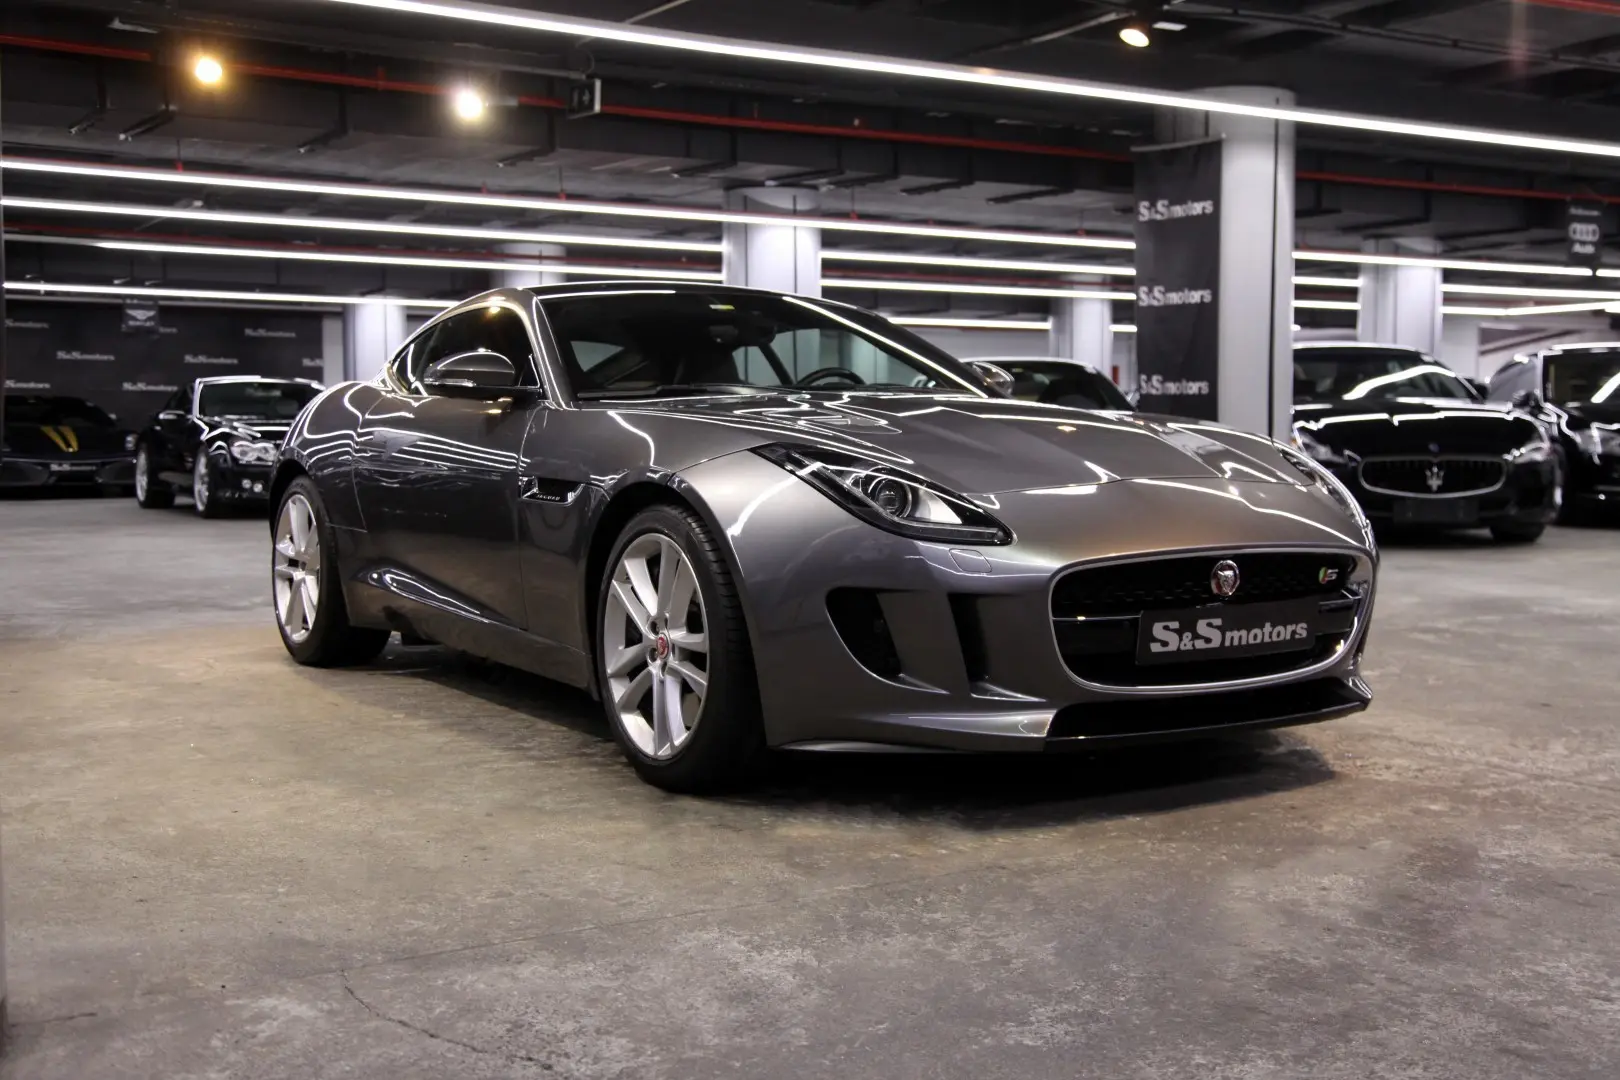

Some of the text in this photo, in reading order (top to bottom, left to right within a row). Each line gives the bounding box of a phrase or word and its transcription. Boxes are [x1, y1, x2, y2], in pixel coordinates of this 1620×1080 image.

[1138, 286, 1213, 307] S&Smotors
[1139, 374, 1209, 395] S&Smotors
[1150, 618, 1308, 653] S&Smotors
